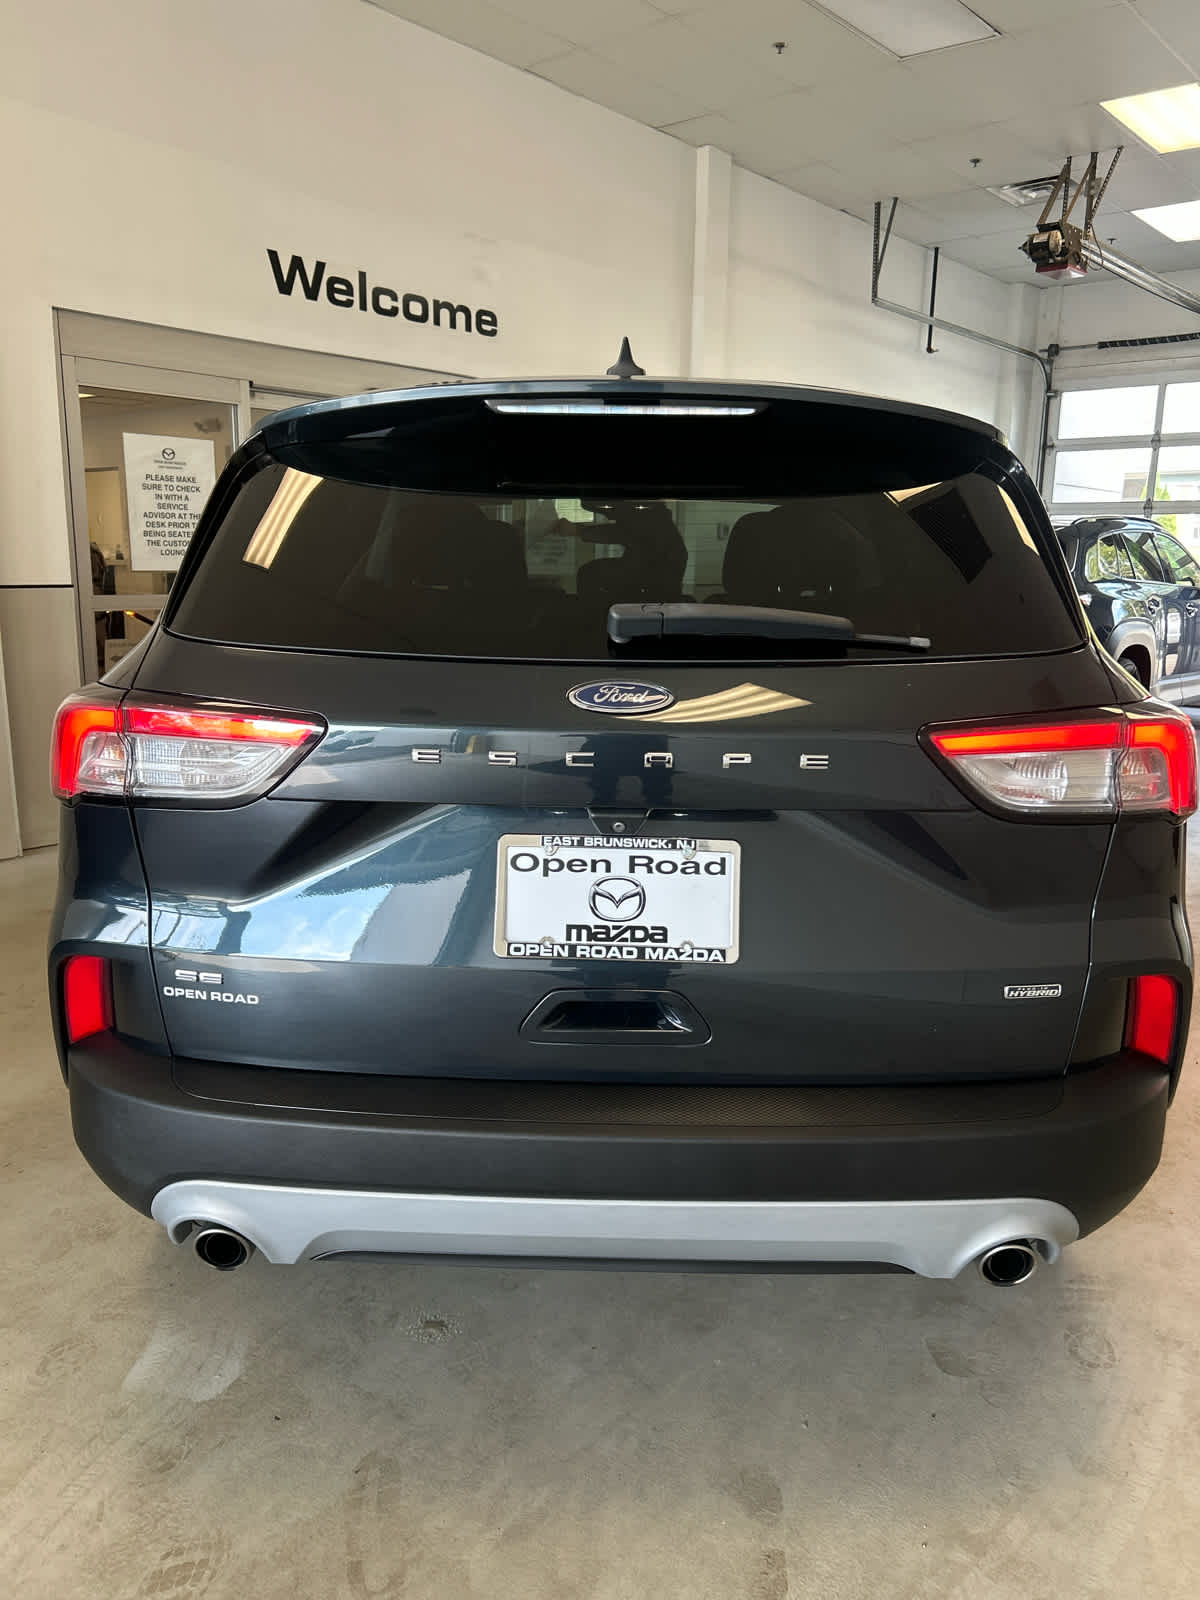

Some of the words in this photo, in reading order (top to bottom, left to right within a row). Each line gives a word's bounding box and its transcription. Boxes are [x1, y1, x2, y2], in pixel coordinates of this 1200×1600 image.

[266, 248, 498, 338] Welcome
[145, 473, 175, 482] PLEASE
[176, 475, 197, 484] MAKE
[142, 482, 162, 491] SURE
[164, 484, 175, 492] TO
[176, 484, 201, 493] CHECK
[184, 494, 190, 502] A
[157, 502, 189, 511] SERVICE
[143, 511, 176, 519] ADVISOR
[177, 512, 187, 520] AT
[168, 521, 190, 529] PRIOR
[143, 530, 166, 538] BEING
[147, 539, 161, 547] THE
[163, 539, 190, 547] CUSTO
[160, 548, 186, 556] LOUNG
[593, 685, 649, 703] Ford
[411, 747, 830, 771] ESCAPE
[543, 836, 581, 848] EAST
[584, 837, 672, 850] BRUNSWICK,
[677, 839, 697, 850] NJ
[510, 852, 612, 877] Open
[628, 855, 727, 876] Road
[565, 923, 669, 944] mazda
[509, 943, 569, 958] OPEN
[576, 944, 638, 960] ROAD
[644, 946, 725, 962] MAZDA
[174, 968, 223, 985] SE
[163, 986, 207, 1000] OPEN
[210, 991, 260, 1005] ROAD
[1008, 989, 1059, 997] HYBRID
